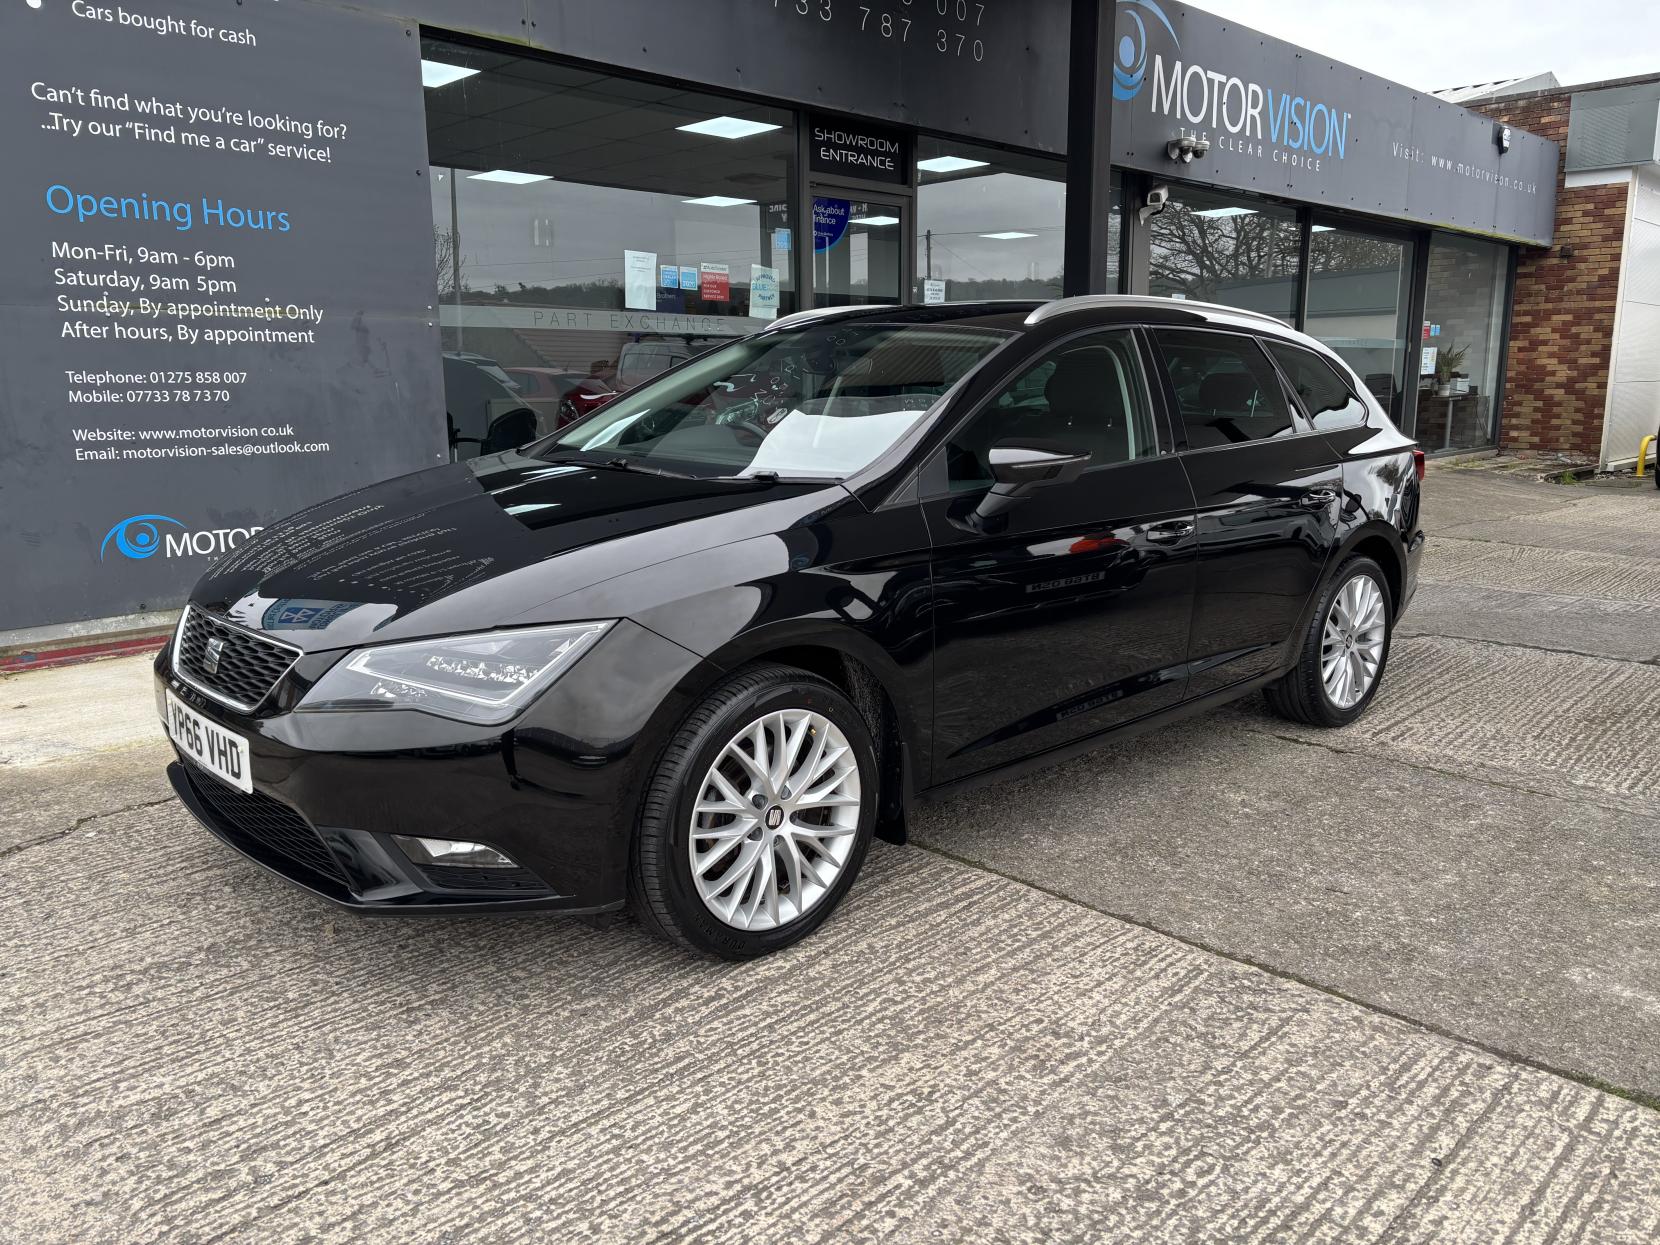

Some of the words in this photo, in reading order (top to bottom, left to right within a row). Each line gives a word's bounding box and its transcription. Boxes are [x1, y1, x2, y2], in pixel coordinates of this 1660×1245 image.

[71, 0, 114, 22] Cars
[118, 7, 187, 35] bought
[190, 20, 214, 39] for
[219, 29, 256, 46] cash
[860, 6, 911, 42] 787
[937, 30, 983, 61] 370
[31, 82, 85, 105] Can't
[89, 89, 129, 111] find
[134, 97, 183, 118] what
[187, 107, 243, 125] you're
[248, 110, 312, 139] looking
[316, 120, 346, 139] for?
[88, 122, 122, 137] our
[181, 132, 210, 147] me
[216, 137, 225, 149] a
[268, 143, 331, 163] service!
[814, 127, 899, 153] SHOWROOM
[1217, 136, 1263, 158] CLEAR
[1273, 150, 1321, 171] CHOICE
[820, 147, 895, 170] ENTRANCE
[47, 185, 191, 230] Opening
[203, 198, 289, 231] Hours
[52, 241, 133, 264] Mon-Fri,
[137, 247, 178, 264] 9am
[195, 251, 235, 270] 6pm
[54, 268, 145, 291] Saturday,
[149, 273, 189, 290] 9am
[197, 276, 236, 295] 5pm
[57, 295, 135, 316] Sunday,
[139, 298, 163, 319] By
[167, 301, 282, 320] appointment
[286, 304, 324, 325] Only
[533, 311, 593, 327] PART
[610, 313, 726, 331] EXCHANGE
[61, 321, 109, 338] After
[114, 322, 172, 342] hours,
[177, 325, 199, 344] By
[204, 327, 315, 345] appointment
[65, 370, 147, 386] Telephone:
[150, 372, 192, 383] 01275
[196, 372, 220, 383] 858
[223, 372, 247, 384] 007
[69, 390, 123, 402] Mobile:
[127, 390, 170, 402] 07733
[72, 428, 135, 441] Website:
[75, 447, 120, 460] Email:
[123, 441, 329, 459] motorvision-sales@outlook.com
[205, 726, 241, 780] VHD
